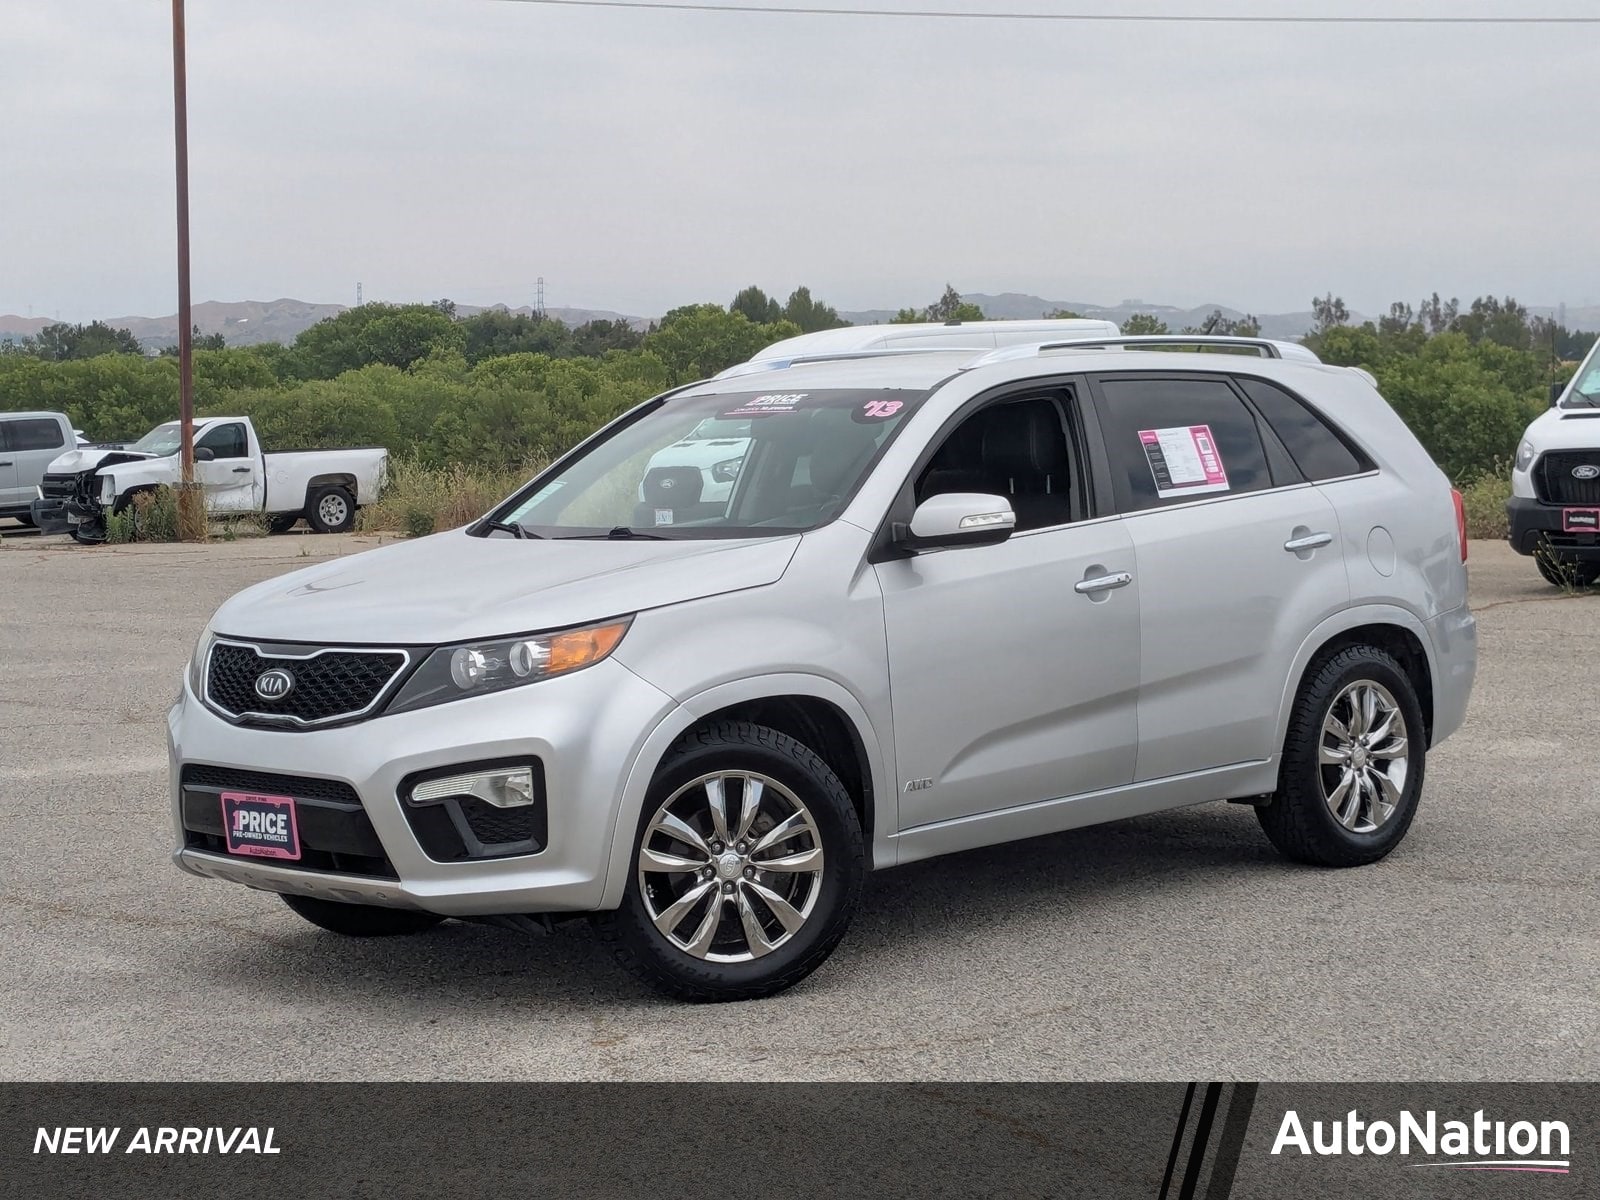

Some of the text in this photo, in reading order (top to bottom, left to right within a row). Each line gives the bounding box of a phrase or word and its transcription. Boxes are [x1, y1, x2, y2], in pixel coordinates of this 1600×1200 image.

[260, 677, 283, 693] KIA
[232, 809, 288, 835] 1PRICE
[232, 830, 288, 843] PRE-OWNED VEHICLES
